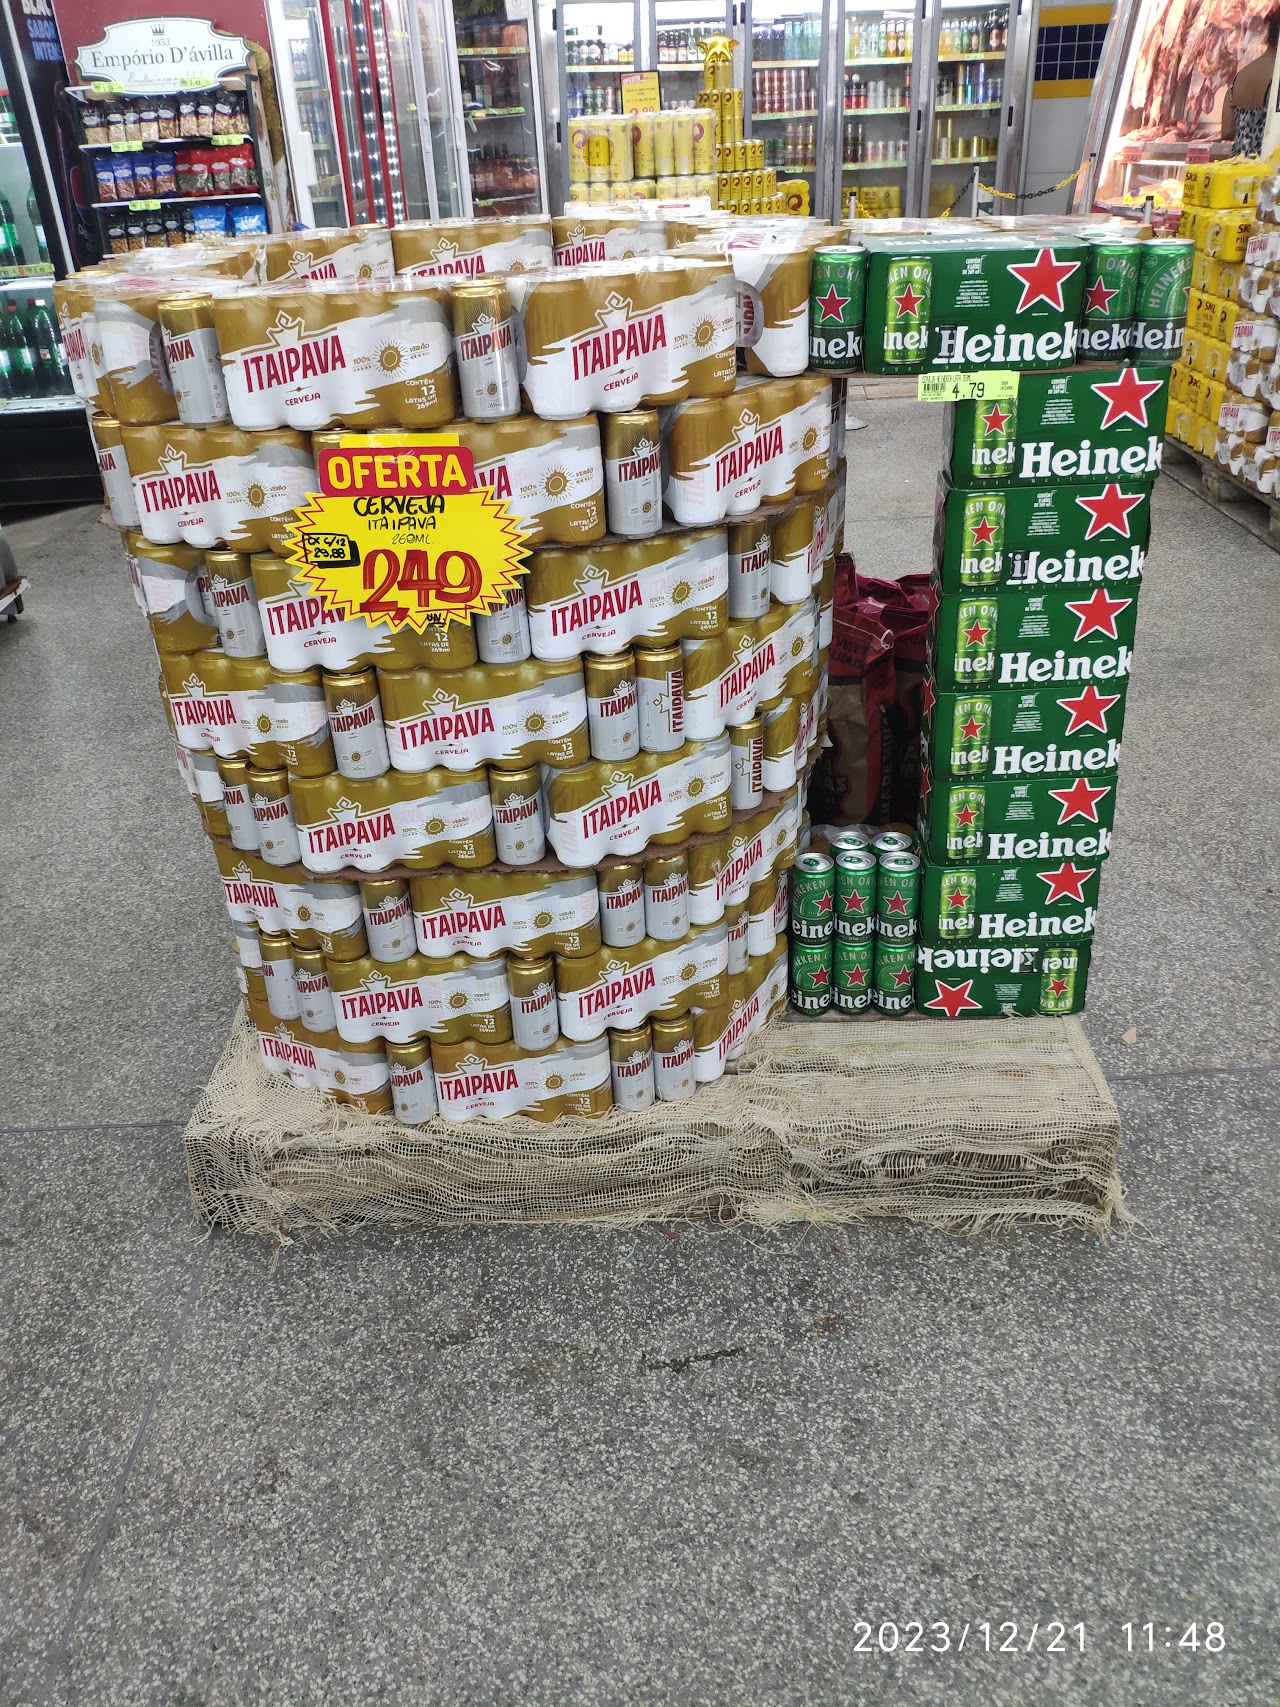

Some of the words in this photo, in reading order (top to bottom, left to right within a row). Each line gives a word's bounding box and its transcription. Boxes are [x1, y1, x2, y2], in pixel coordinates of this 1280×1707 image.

[92, 49, 165, 70] Empório
[460, 325, 512, 362] ITAIPAVA
[572, 313, 667, 381] ITAIPAVA
[672, 333, 689, 343] 100%
[242, 335, 346, 394] ITAIPAVA
[352, 356, 372, 366] 100%
[421, 385, 436, 395] 12
[603, 372, 639, 392] CERVEJA
[284, 392, 321, 408] CERVEJA
[716, 426, 783, 492] ITAIPAVA
[327, 453, 467, 489] OFERTA
[519, 484, 537, 493] 100%
[575, 468, 594, 477] VERÃO
[141, 469, 221, 513] ITAIPAVA
[226, 490, 241, 498] 100%
[735, 479, 762, 498] CERVEJA
[353, 495, 445, 517] CERVEJA
[570, 500, 596, 510] CONTÉM
[586, 507, 597, 516] 12
[177, 517, 204, 528] CERVEJA
[368, 516, 436, 530] ITAIPAVA
[697, 575, 715, 586] VERÃO
[551, 580, 643, 637] ITAIPAVA
[706, 611, 717, 619] 12
[303, 636, 337, 648] CERVEJA
[435, 633, 449, 642] 12
[581, 629, 616, 640] CERVEJA
[719, 642, 776, 708] ITAIPAVA
[671, 669, 684, 733] ITAIPAVA
[736, 691, 758, 711] CERVEJA
[172, 699, 237, 726] ITAIPAVA
[329, 706, 376, 733] ITAIPAVA
[502, 723, 518, 731] 100%
[551, 711, 569, 720] VERÃO
[400, 707, 495, 751] ITAIPAVA
[561, 743, 573, 751] 12
[668, 790, 682, 798] 100%
[495, 797, 538, 824] ITAIPAVA
[582, 779, 663, 840] ITAIPAVA
[718, 801, 727, 810] 12
[308, 812, 396, 854] ITAIPAVA
[609, 825, 640, 841] CERVEJA
[716, 838, 763, 901] ITAIPAVA
[369, 896, 411, 926] ITAIPAVA
[422, 905, 507, 940] ITAIPAVA
[568, 935, 580, 943] 12
[342, 986, 424, 1020] ITAIPAVA
[578, 967, 656, 1019] ITAIPAVA
[603, 1007, 633, 1021] CERVEJA
[718, 995, 759, 1060] ITAIPAVA
[262, 1038, 317, 1070] ITAIPAVA
[438, 1068, 519, 1101] ITAIPAVA
[466, 1100, 495, 1110] CERVEJA
